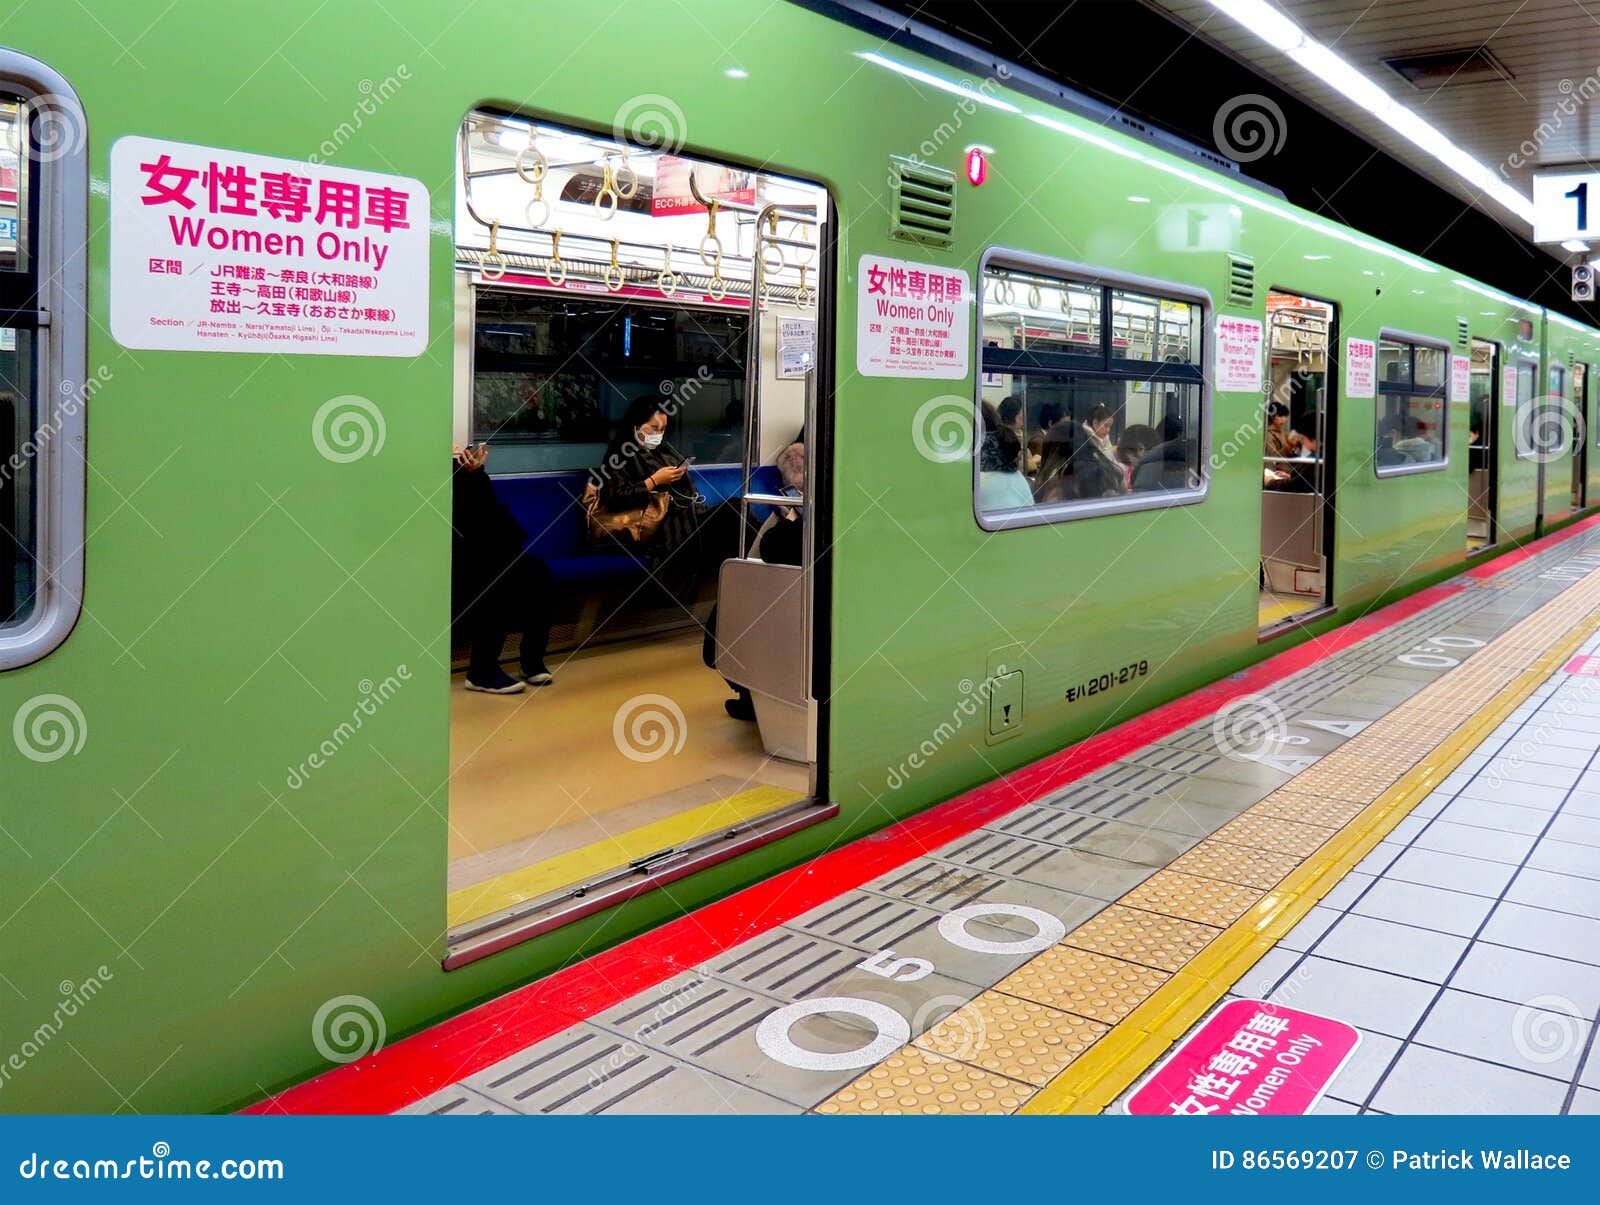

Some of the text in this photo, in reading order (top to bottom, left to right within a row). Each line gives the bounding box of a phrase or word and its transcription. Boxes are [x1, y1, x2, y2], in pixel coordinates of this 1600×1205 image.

[139, 154, 411, 233] 女性専用車
[1564, 182, 1588, 231] 1
[168, 214, 389, 271] Women Only
[148, 258, 182, 275] 区間
[867, 264, 962, 304] 女性専用車
[150, 317, 185, 327] Section
[877, 299, 954, 328] Women Only
[1275, 1032, 1323, 1066] Only
